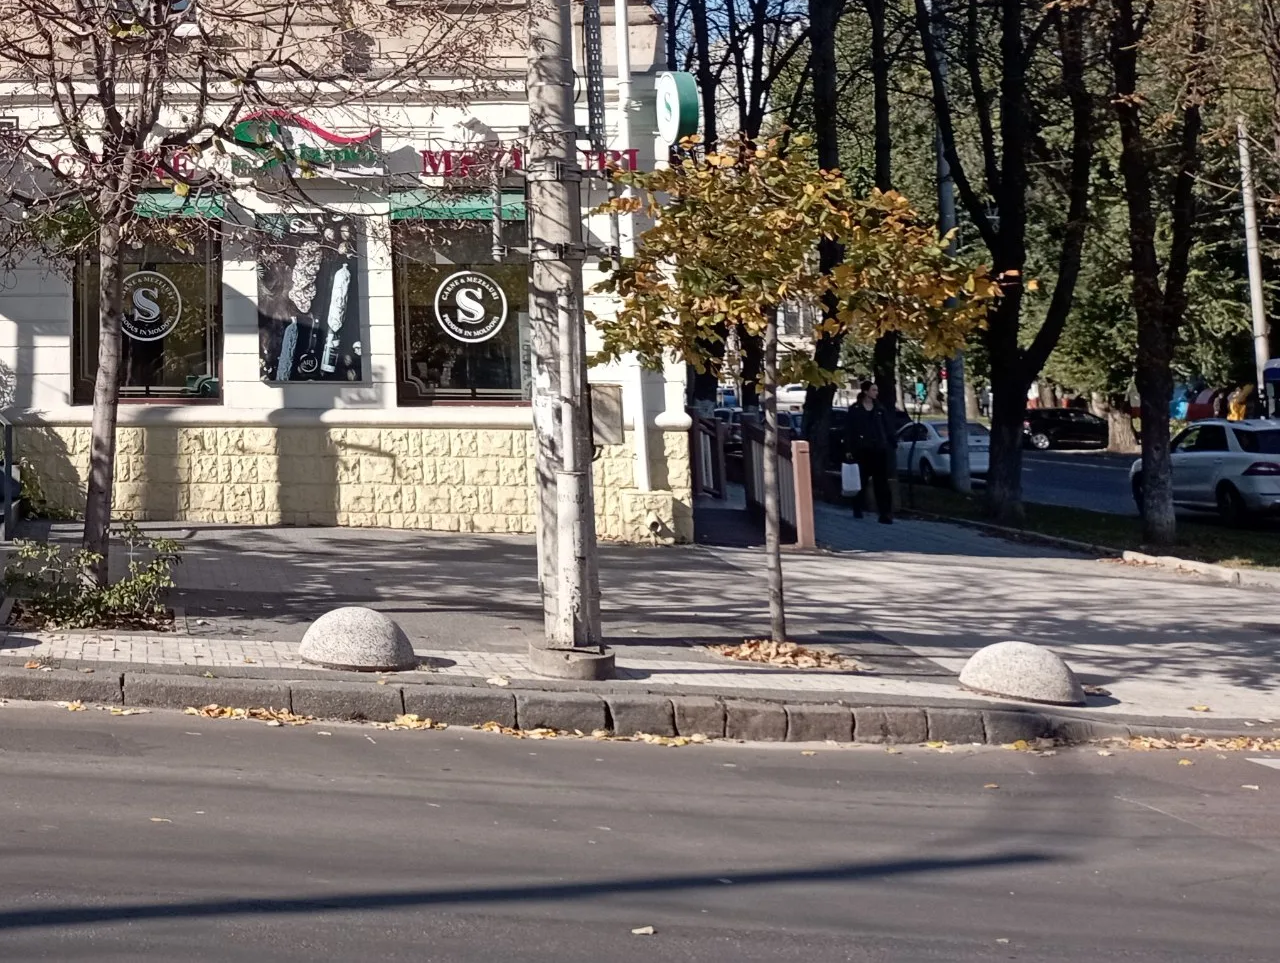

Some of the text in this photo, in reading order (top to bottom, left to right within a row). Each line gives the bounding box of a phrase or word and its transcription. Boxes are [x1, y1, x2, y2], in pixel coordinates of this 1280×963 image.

[441, 279, 460, 301] CARNE
[466, 276, 500, 301] MEZELURI
[132, 287, 160, 323] S
[455, 287, 485, 324] S
[139, 328, 148, 336] IN
[148, 315, 176, 336] MOLDOVA
[442, 313, 464, 335] PRODUS
[473, 315, 500, 337] MOLDOVA
